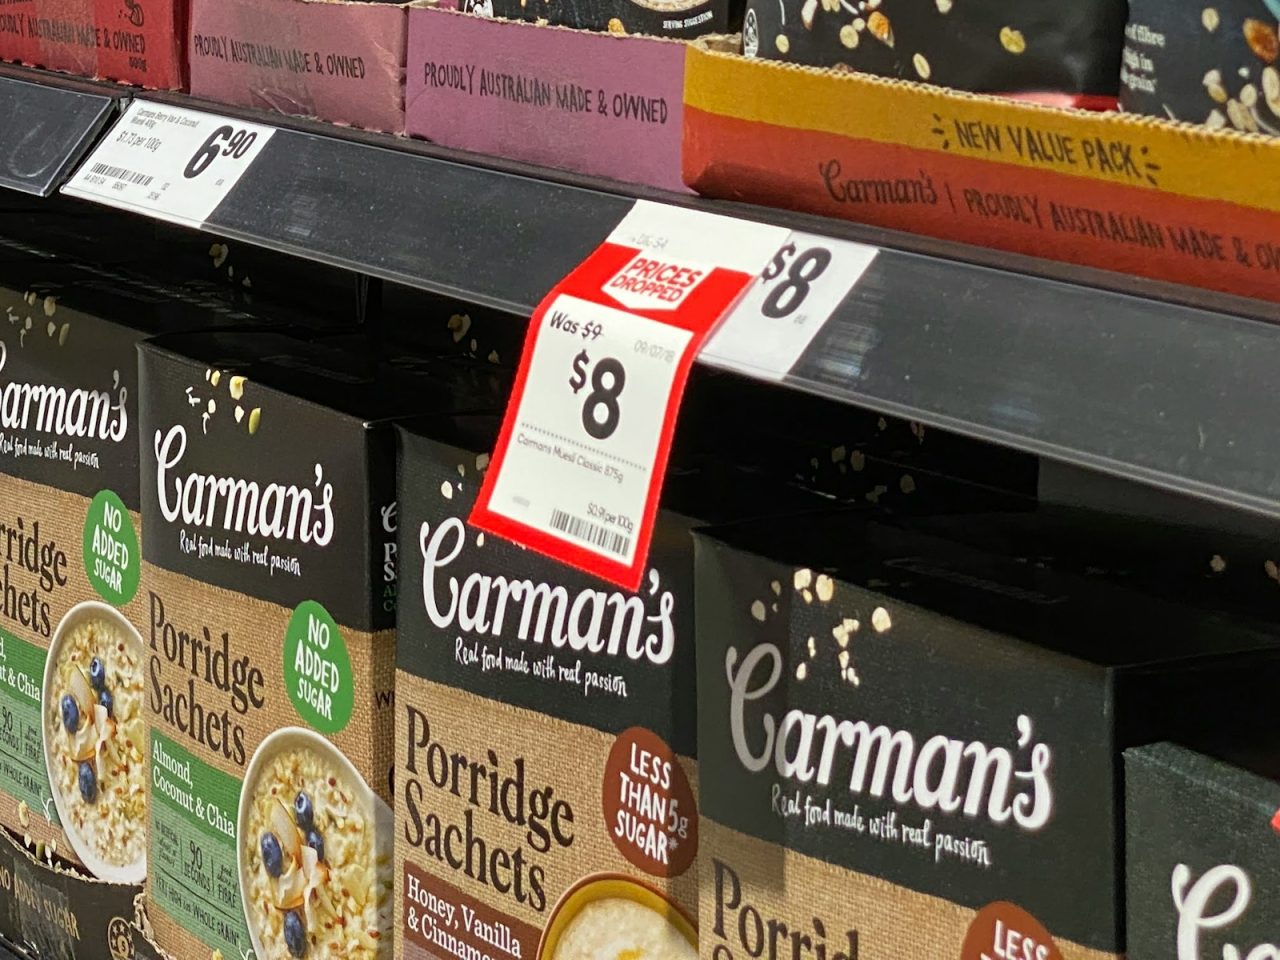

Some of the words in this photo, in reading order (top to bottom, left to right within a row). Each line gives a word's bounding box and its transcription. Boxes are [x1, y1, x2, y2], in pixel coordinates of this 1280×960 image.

[424, 61, 476, 96] PROUDLY
[480, 68, 551, 106] AUSTRALIAN
[556, 84, 593, 113] MADE
[597, 92, 608, 114] &
[612, 93, 668, 125] OWNED
[954, 120, 1002, 152] NEW
[1008, 125, 1075, 166] VALUE
[1082, 138, 1142, 179] PACK
[819, 159, 938, 205] Carman's
[963, 188, 1042, 229] PROUDLY
[1049, 201, 1165, 251] AUSTRALIAN
[610, 275, 688, 303] DROPPED
[627, 256, 703, 292] PRICES
[760, 240, 832, 320] $8
[550, 310, 579, 335] Was
[580, 320, 605, 341] $9
[569, 348, 626, 440] $8
[154, 424, 334, 546] Carman's
[517, 433, 552, 455] Carmans
[552, 445, 576, 463] Muesli
[577, 455, 603, 473] Classic
[604, 465, 624, 484] 875g
[103, 501, 122, 533] NO
[91, 525, 129, 570] ADDED
[93, 561, 123, 595] SUGAR
[420, 517, 675, 665] Carman's
[148, 590, 266, 715] Porridge
[307, 612, 330, 651] NO
[8, 668, 16, 688] &
[17, 671, 41, 702] Chia
[294, 647, 340, 694] ADDED
[455, 637, 479, 664] Real
[481, 643, 503, 671] food
[504, 654, 530, 677] made
[532, 655, 556, 680] with
[558, 659, 581, 685] real
[584, 670, 628, 697] passion
[149, 655, 247, 767] Sachets
[295, 683, 334, 721] SUGAR
[152, 739, 193, 789] Almond,
[629, 742, 672, 790] LESS
[725, 643, 1052, 831] Carman's
[153, 770, 195, 816] Coconut
[195, 796, 205, 820] &
[206, 802, 236, 839] Chia
[405, 703, 575, 854] Porridge
[619, 771, 666, 825] THAN
[668, 797, 689, 839] 5g
[404, 778, 546, 912] Sachets
[771, 784, 800, 817] Real
[804, 796, 830, 827] food
[833, 804, 864, 832] made
[869, 810, 898, 839] with
[901, 818, 931, 847] real
[934, 832, 993, 869] passion
[407, 873, 459, 930] Honey,
[460, 902, 522, 958] Vanilla
[407, 911, 419, 935] &
